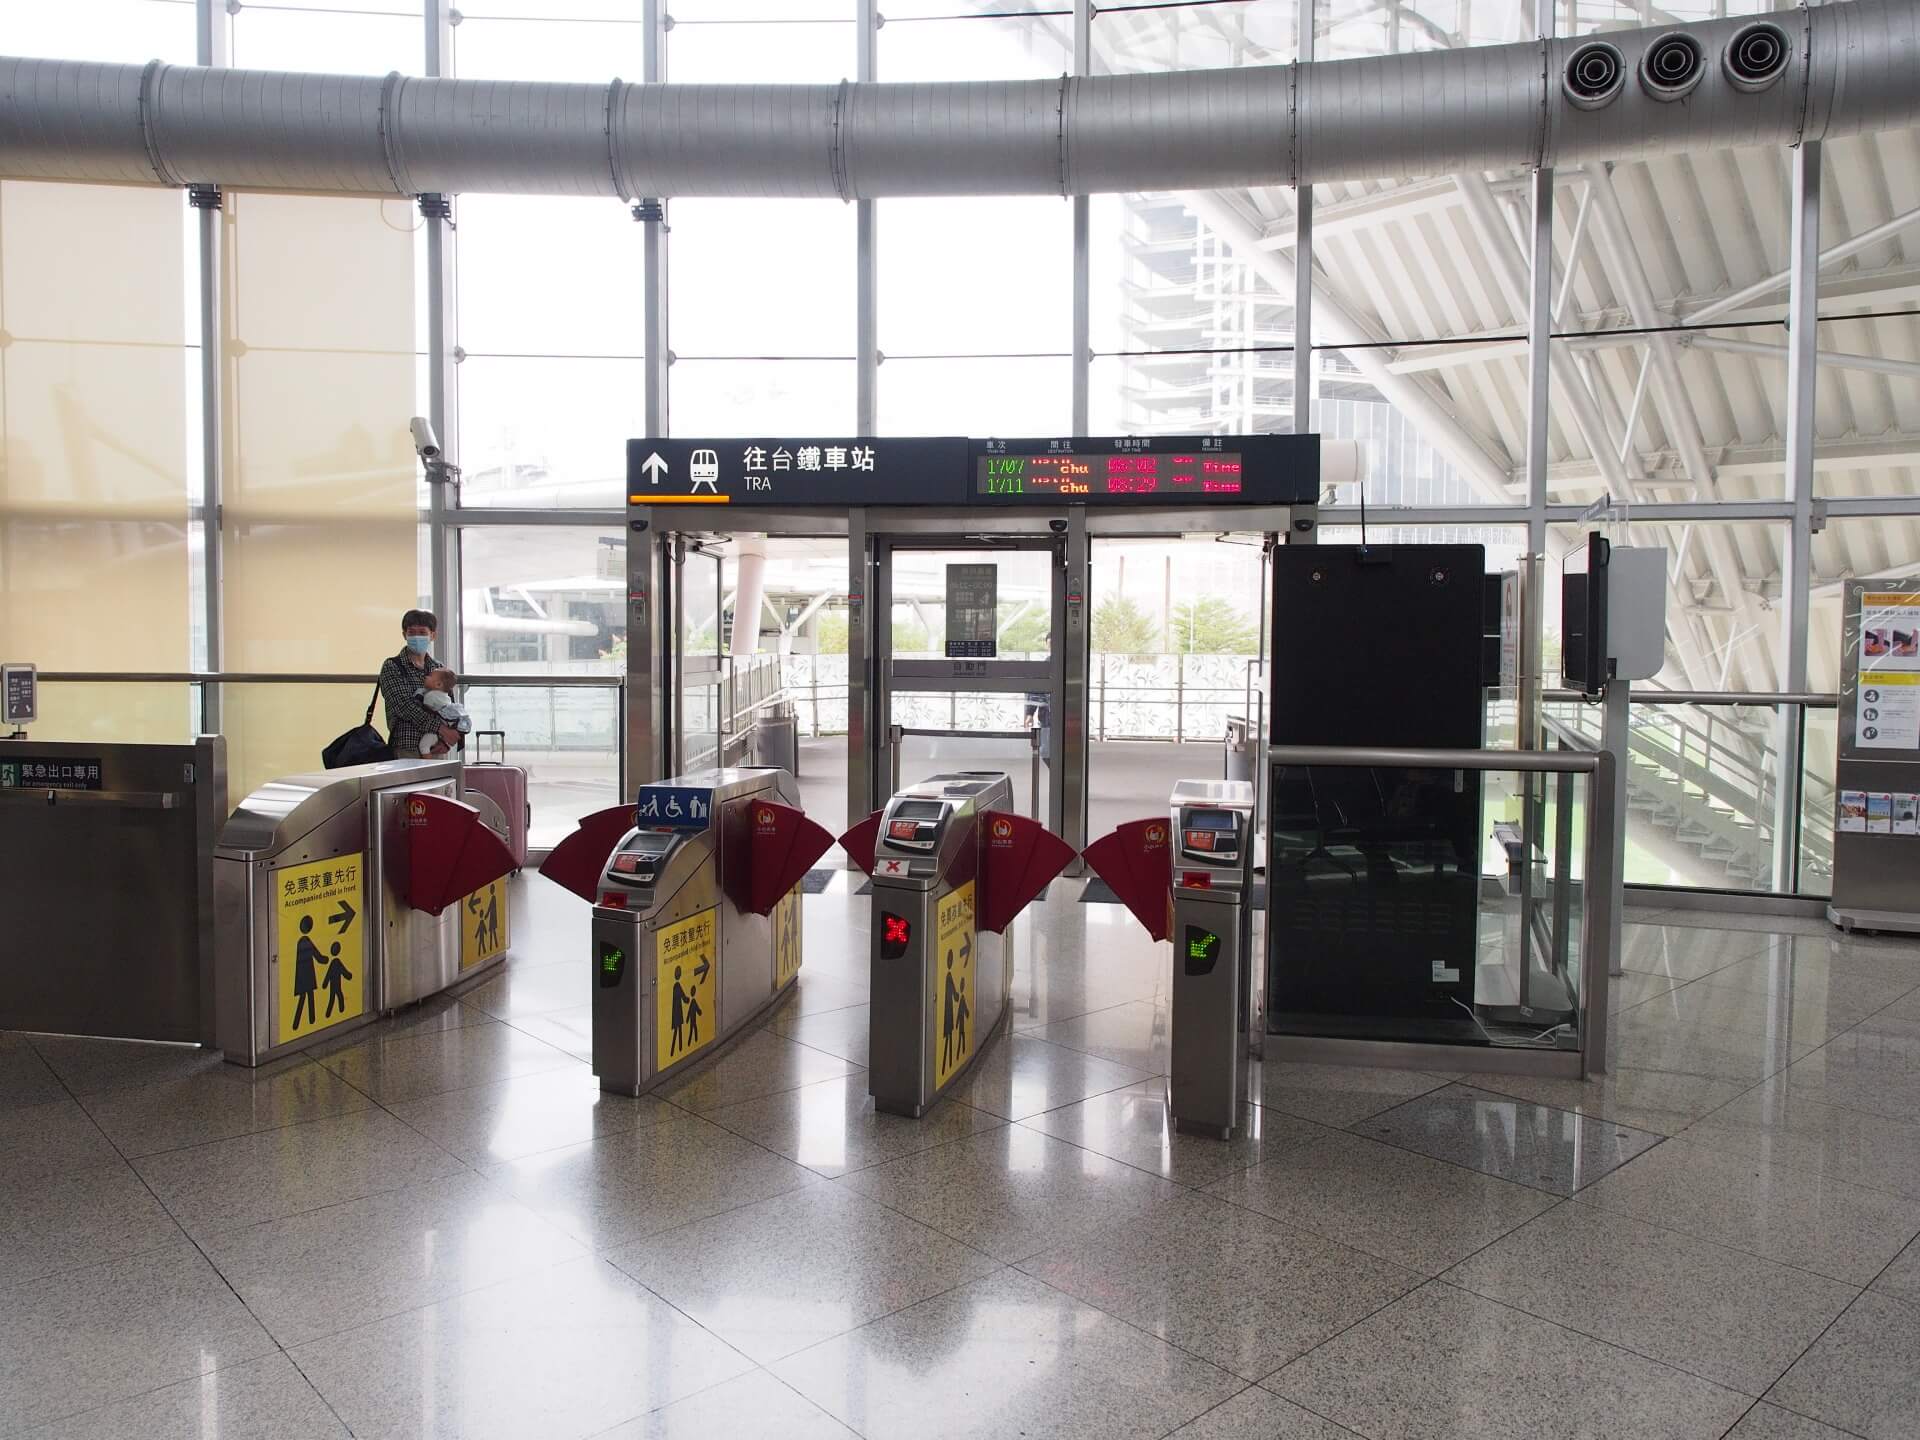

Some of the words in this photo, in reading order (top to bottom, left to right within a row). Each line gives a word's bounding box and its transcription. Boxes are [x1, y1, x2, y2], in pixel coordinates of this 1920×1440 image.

[743, 445, 876, 472] 往台鐵車站
[743, 476, 772, 491] TRA
[22, 763, 99, 780] 緊急出口專用
[284, 865, 357, 897] 免票孩童先行
